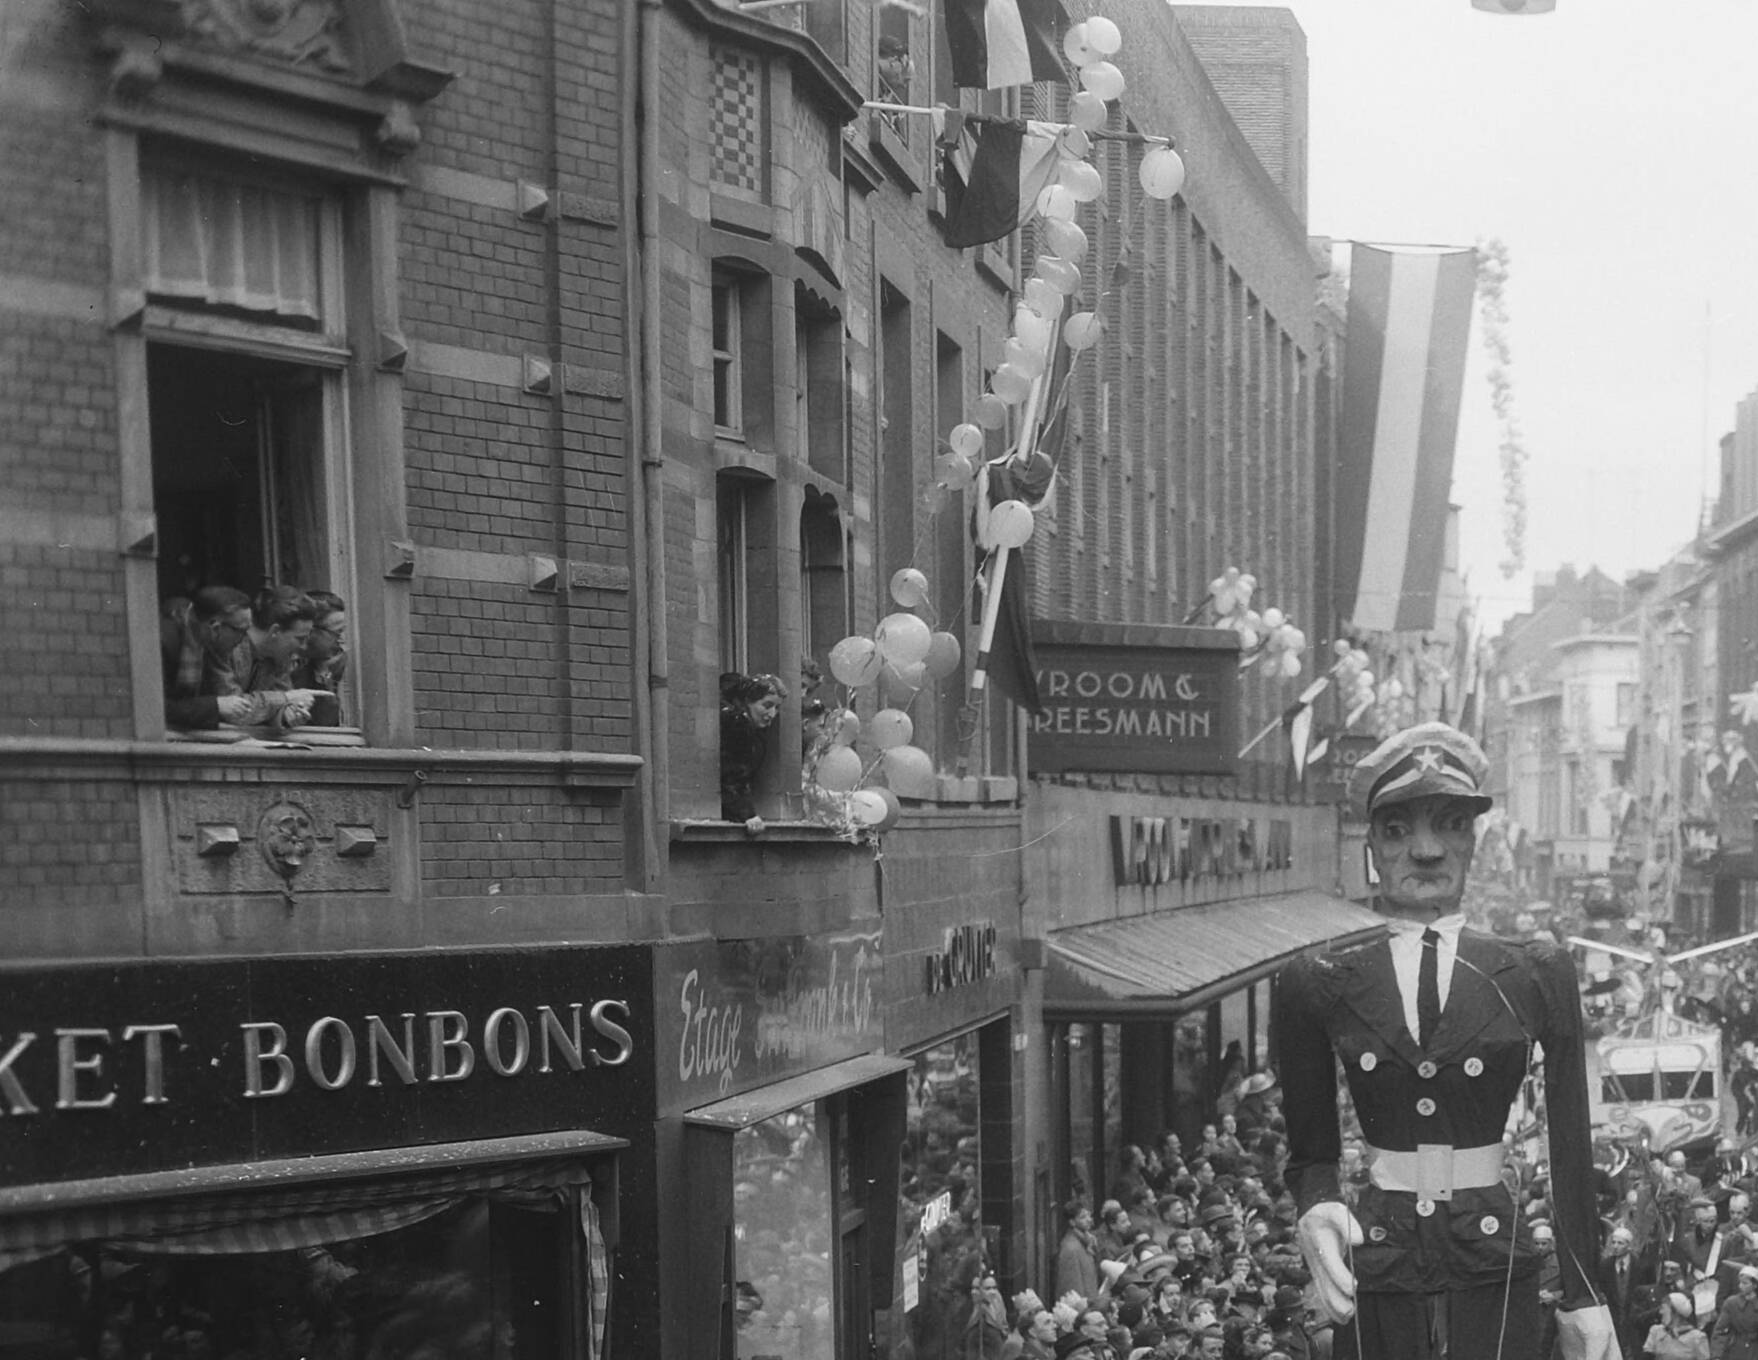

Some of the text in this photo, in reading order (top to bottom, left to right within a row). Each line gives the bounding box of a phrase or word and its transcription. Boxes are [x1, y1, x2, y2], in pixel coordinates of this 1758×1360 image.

[1026, 706, 1210, 737] REESMANN
[0, 1000, 635, 1115] KET BONBONS
[679, 968, 742, 1094] Etage
